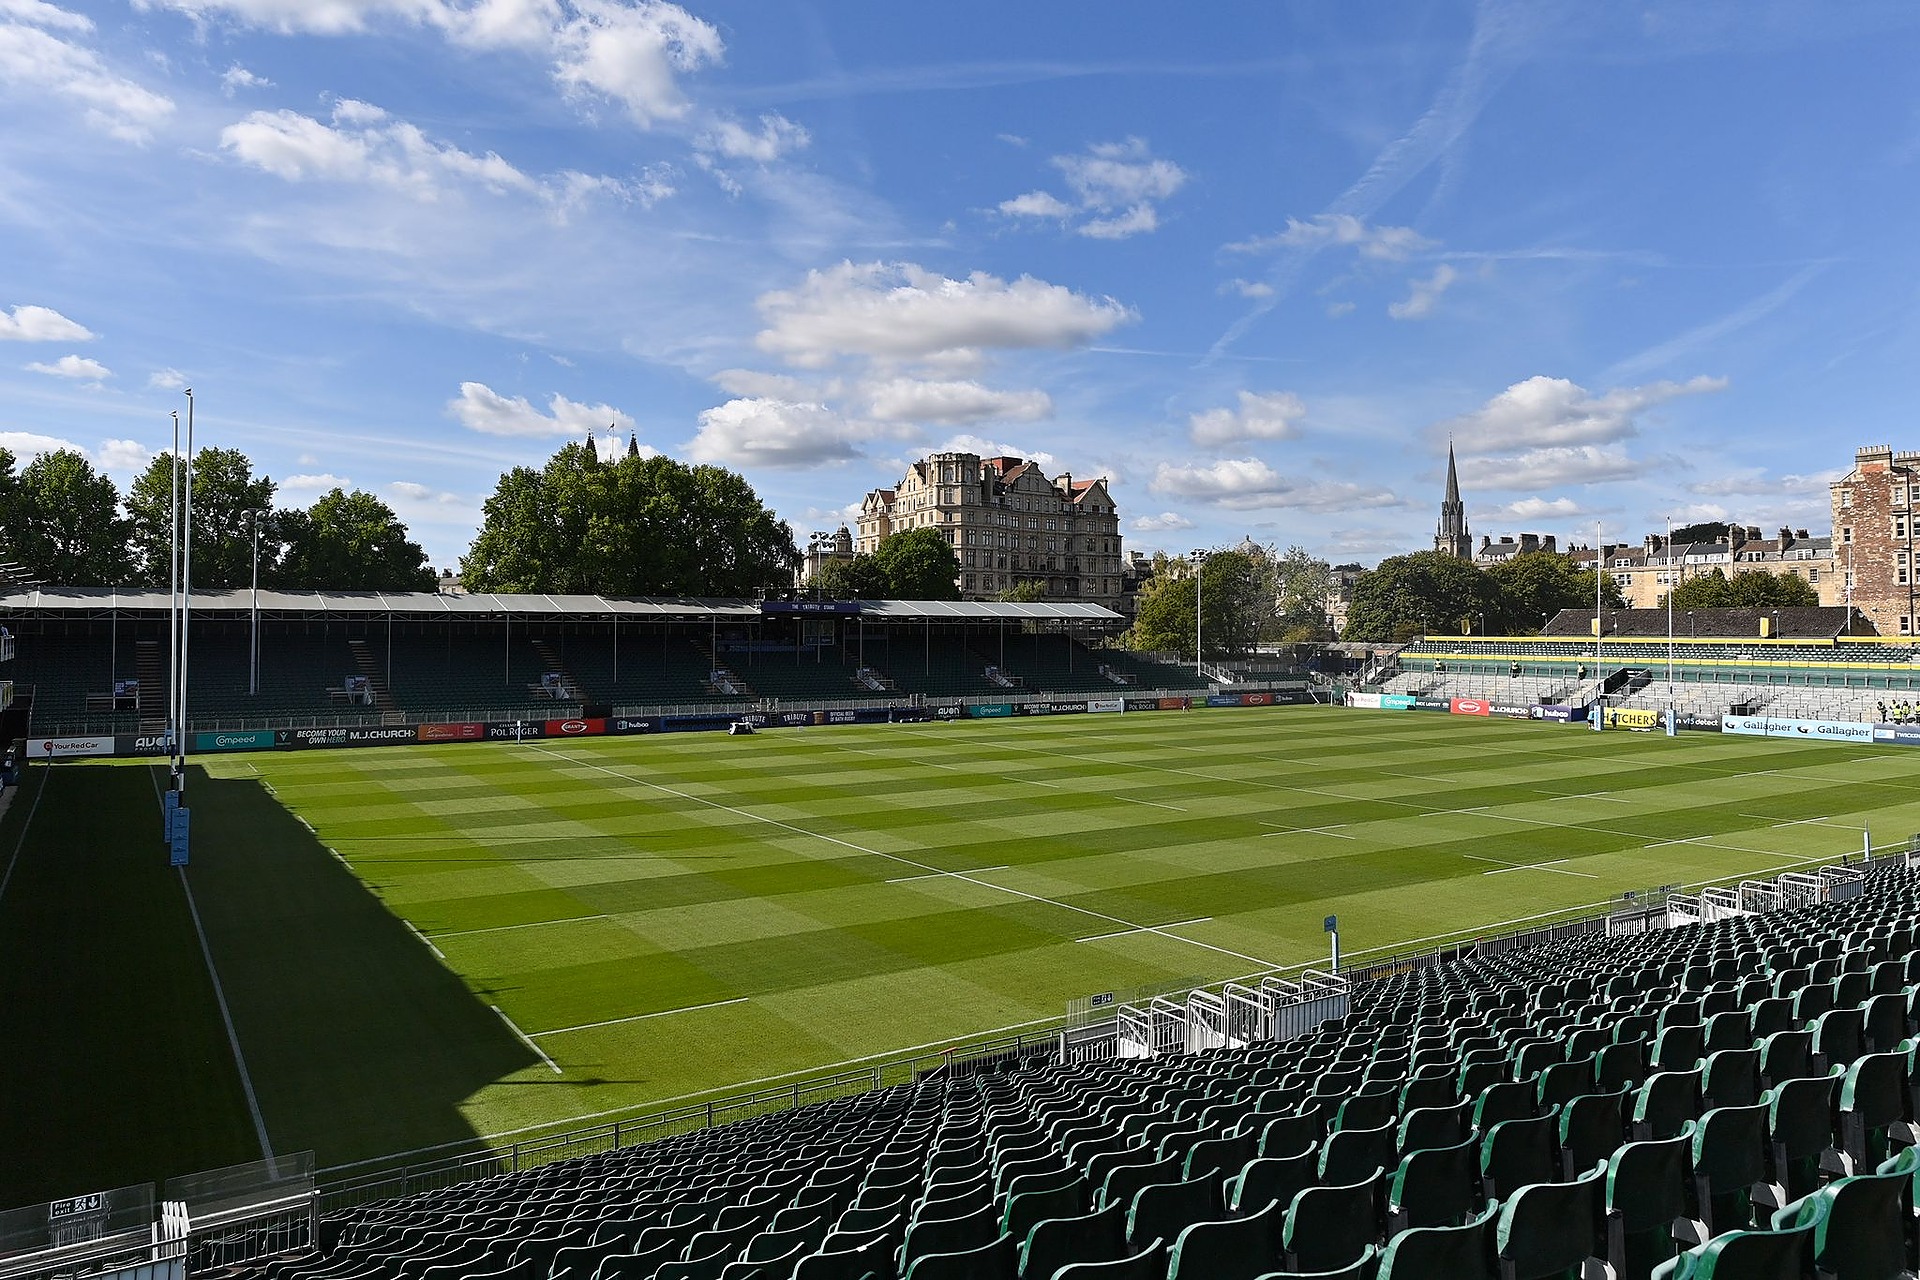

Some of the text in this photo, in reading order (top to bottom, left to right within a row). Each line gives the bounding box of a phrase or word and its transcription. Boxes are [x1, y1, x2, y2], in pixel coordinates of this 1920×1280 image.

[783, 713, 808, 722] TRIBUTE
[1545, 708, 1568, 718] huboo
[1743, 721, 1792, 732] Gallagher
[1818, 726, 1870, 737] Gallagher
[297, 729, 346, 738] BECOME YOUR
[490, 728, 508, 736] POL
[216, 735, 256, 746] Compeed
